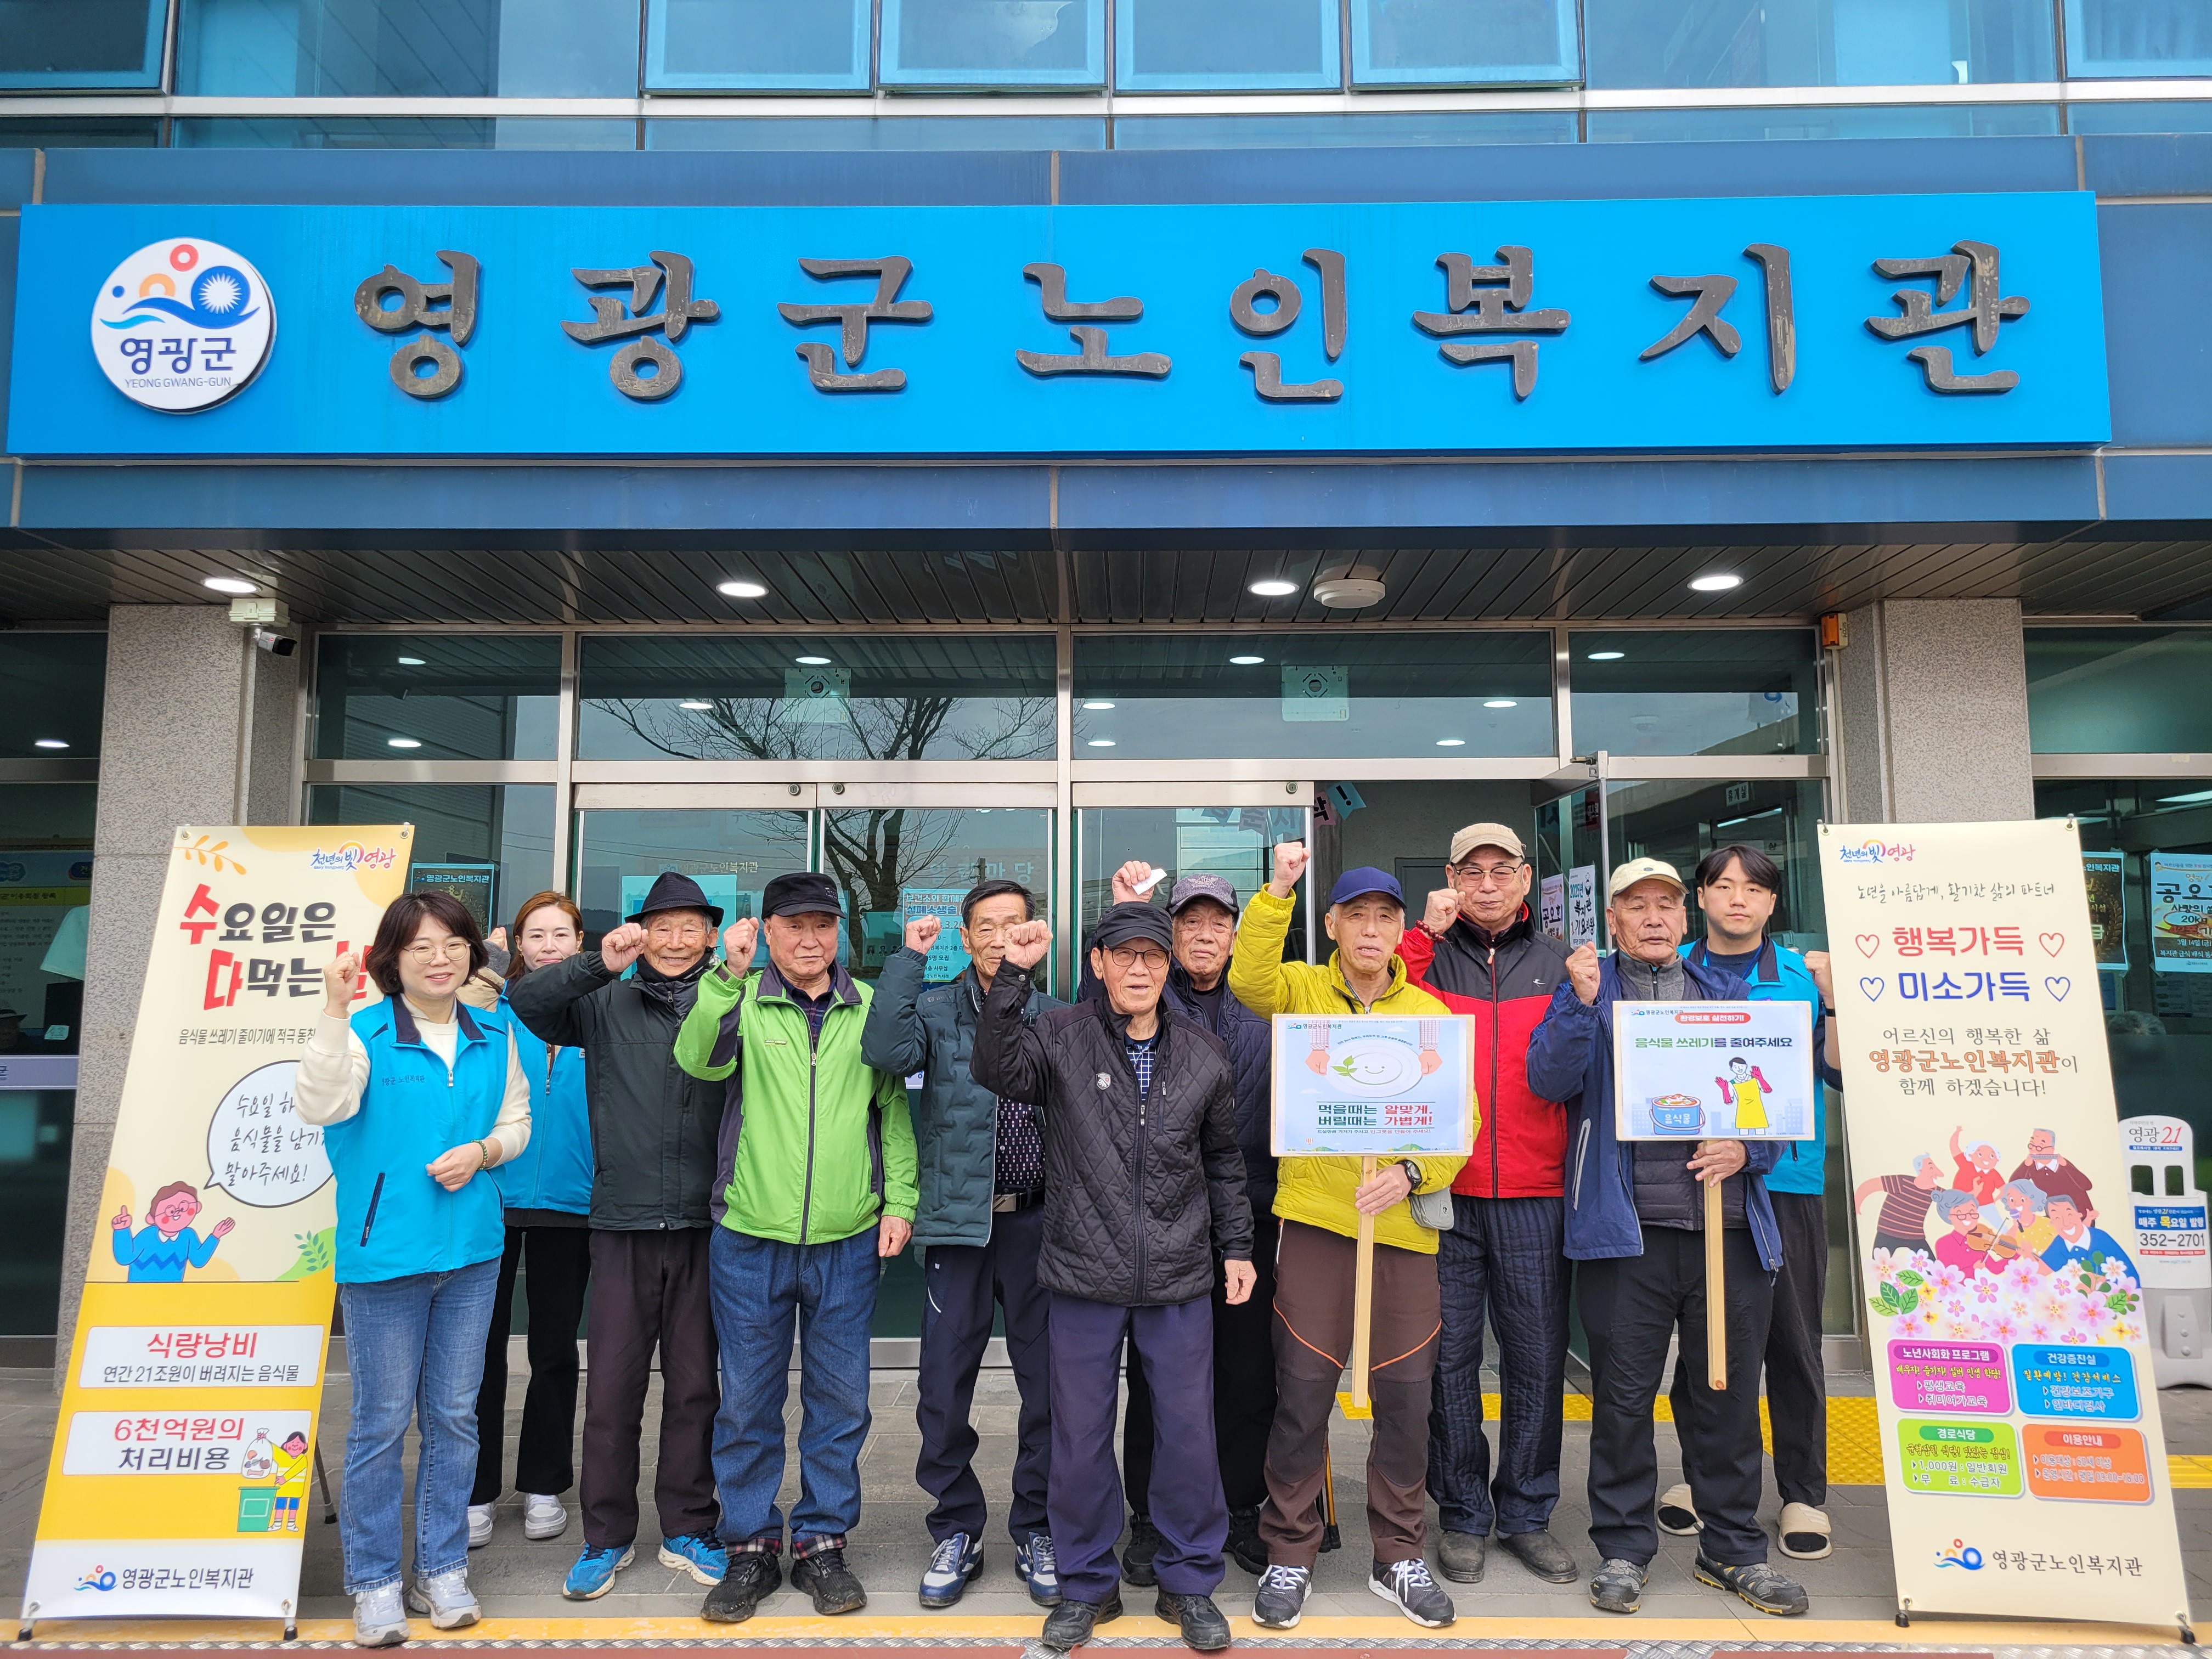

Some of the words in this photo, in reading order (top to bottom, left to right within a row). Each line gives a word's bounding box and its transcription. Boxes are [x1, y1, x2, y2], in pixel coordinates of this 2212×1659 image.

[354, 240, 2031, 401] 영광군노인복지관
[120, 337, 237, 375] 영광군
[125, 379, 161, 388] YEONG
[164, 377, 231, 387] GWANG-GUN
[311, 849, 342, 866] 천년의
[345, 849, 357, 871] 빛
[364, 848, 397, 869] 영광
[1839, 845, 1867, 860] 천년의
[1869, 845, 1883, 863] 빛
[1887, 844, 1916, 861] 영광
[680, 861, 759, 874] 영광군노인복지관
[426, 874, 490, 883] 영광군노인복지관
[1570, 882, 1583, 898] 2025년
[1858, 883, 1886, 903] 노년을
[1892, 883, 1944, 902] 아름답게,
[1949, 883, 1985, 901] 활기찬
[1990, 883, 2015, 901] 삶의
[2021, 883, 2054, 896] 파트너
[906, 894, 939, 903] 보건소와
[180, 883, 336, 945] 수요일은
[906, 904, 957, 915] 심폐소생술
[1574, 898, 1592, 917] 복지관
[2171, 904, 2203, 913] 사랑의
[1543, 904, 1562, 928] 공오회
[2181, 916, 2208, 924] 20kg
[1893, 927, 2023, 957] 행복가득
[1898, 972, 2030, 1002] 미소가득
[179, 1029, 207, 1045] 음식물
[208, 1029, 237, 1044] 쓰레기
[238, 1028, 275, 1045] 줄이기에
[277, 1028, 296, 1044] 적극
[1635, 1038, 1673, 1047] 음식물
[1676, 1037, 1726, 1047] 쓰레기를
[1730, 1037, 1792, 1047] 줄여주세요
[1883, 1028, 1954, 1045] 어르신의
[1966, 1028, 2022, 1045] 행복한
[2033, 1028, 2051, 1045] 삶
[1869, 1049, 2078, 1074] 영광군노인복지관이
[1899, 1078, 1935, 1096] 함께
[1947, 1078, 2046, 1097] 하겠습니다!
[237, 1094, 273, 1118] 수요일
[1318, 1105, 1377, 1114] 먹을때는
[1384, 1105, 1433, 1114] 알맞게,
[1318, 1116, 1377, 1125] 버릴때는
[1384, 1116, 1432, 1126] 가볍게!
[1664, 1114, 1691, 1124] 음식물
[231, 1126, 284, 1153] 음식물을
[291, 1128, 325, 1149] 남기
[225, 1161, 308, 1186] 말아주세요!
[2138, 1217, 2157, 1227] 매주
[2160, 1216, 2187, 1228] 목요일
[2190, 1217, 2204, 1227] 발행
[2140, 1233, 2204, 1246] 352-2701
[146, 1332, 258, 1358] 식량낭비
[1903, 1347, 1950, 1359] 노년사회화
[1952, 1349, 1990, 1361] 프로그램
[2047, 1353, 2097, 1365] 건강증진실
[104, 1366, 131, 1383] 연간
[135, 1365, 195, 1383] 21조원이
[199, 1365, 255, 1382] 버려지는
[258, 1364, 299, 1382] 음식물
[1895, 1364, 1920, 1376] 배우자!
[1922, 1365, 1946, 1377] 즐기자!
[1949, 1366, 1963, 1379] 실버
[1923, 1380, 1965, 1392] 평생교육
[2050, 1385, 2115, 1399] 건강보조기구
[1926, 1393, 1987, 1407] 취미여가교육
[2052, 1399, 2106, 1413] 인바디검사
[114, 1418, 245, 1441] 6천억원의
[1937, 1428, 1976, 1440] 경로식당
[2063, 1434, 2103, 1446] 이용안내
[119, 1447, 230, 1470] 처리비용
[1906, 1443, 1938, 1457] 균형잡힌
[1941, 1445, 1961, 1457] 식단!
[1963, 1446, 1988, 1458] 맛있는
[1990, 1448, 2010, 1459] 점심!
[1919, 1461, 1957, 1472] 1,000원
[1967, 1462, 2007, 1475] 일반회원
[2040, 1454, 2070, 1466] 이용대상
[2076, 1456, 2094, 1468] 60세
[2095, 1457, 2111, 1469] 이상
[1970, 1476, 2001, 1488] 수급자
[2042, 1469, 2073, 1481] 운영시간
[2078, 1470, 2094, 1482] 평일
[2096, 1471, 2145, 1484] 09:00-18:00
[1993, 1549, 2142, 1577] 영광군노인복지관
[123, 1568, 254, 1589] 영광군노인복지관
